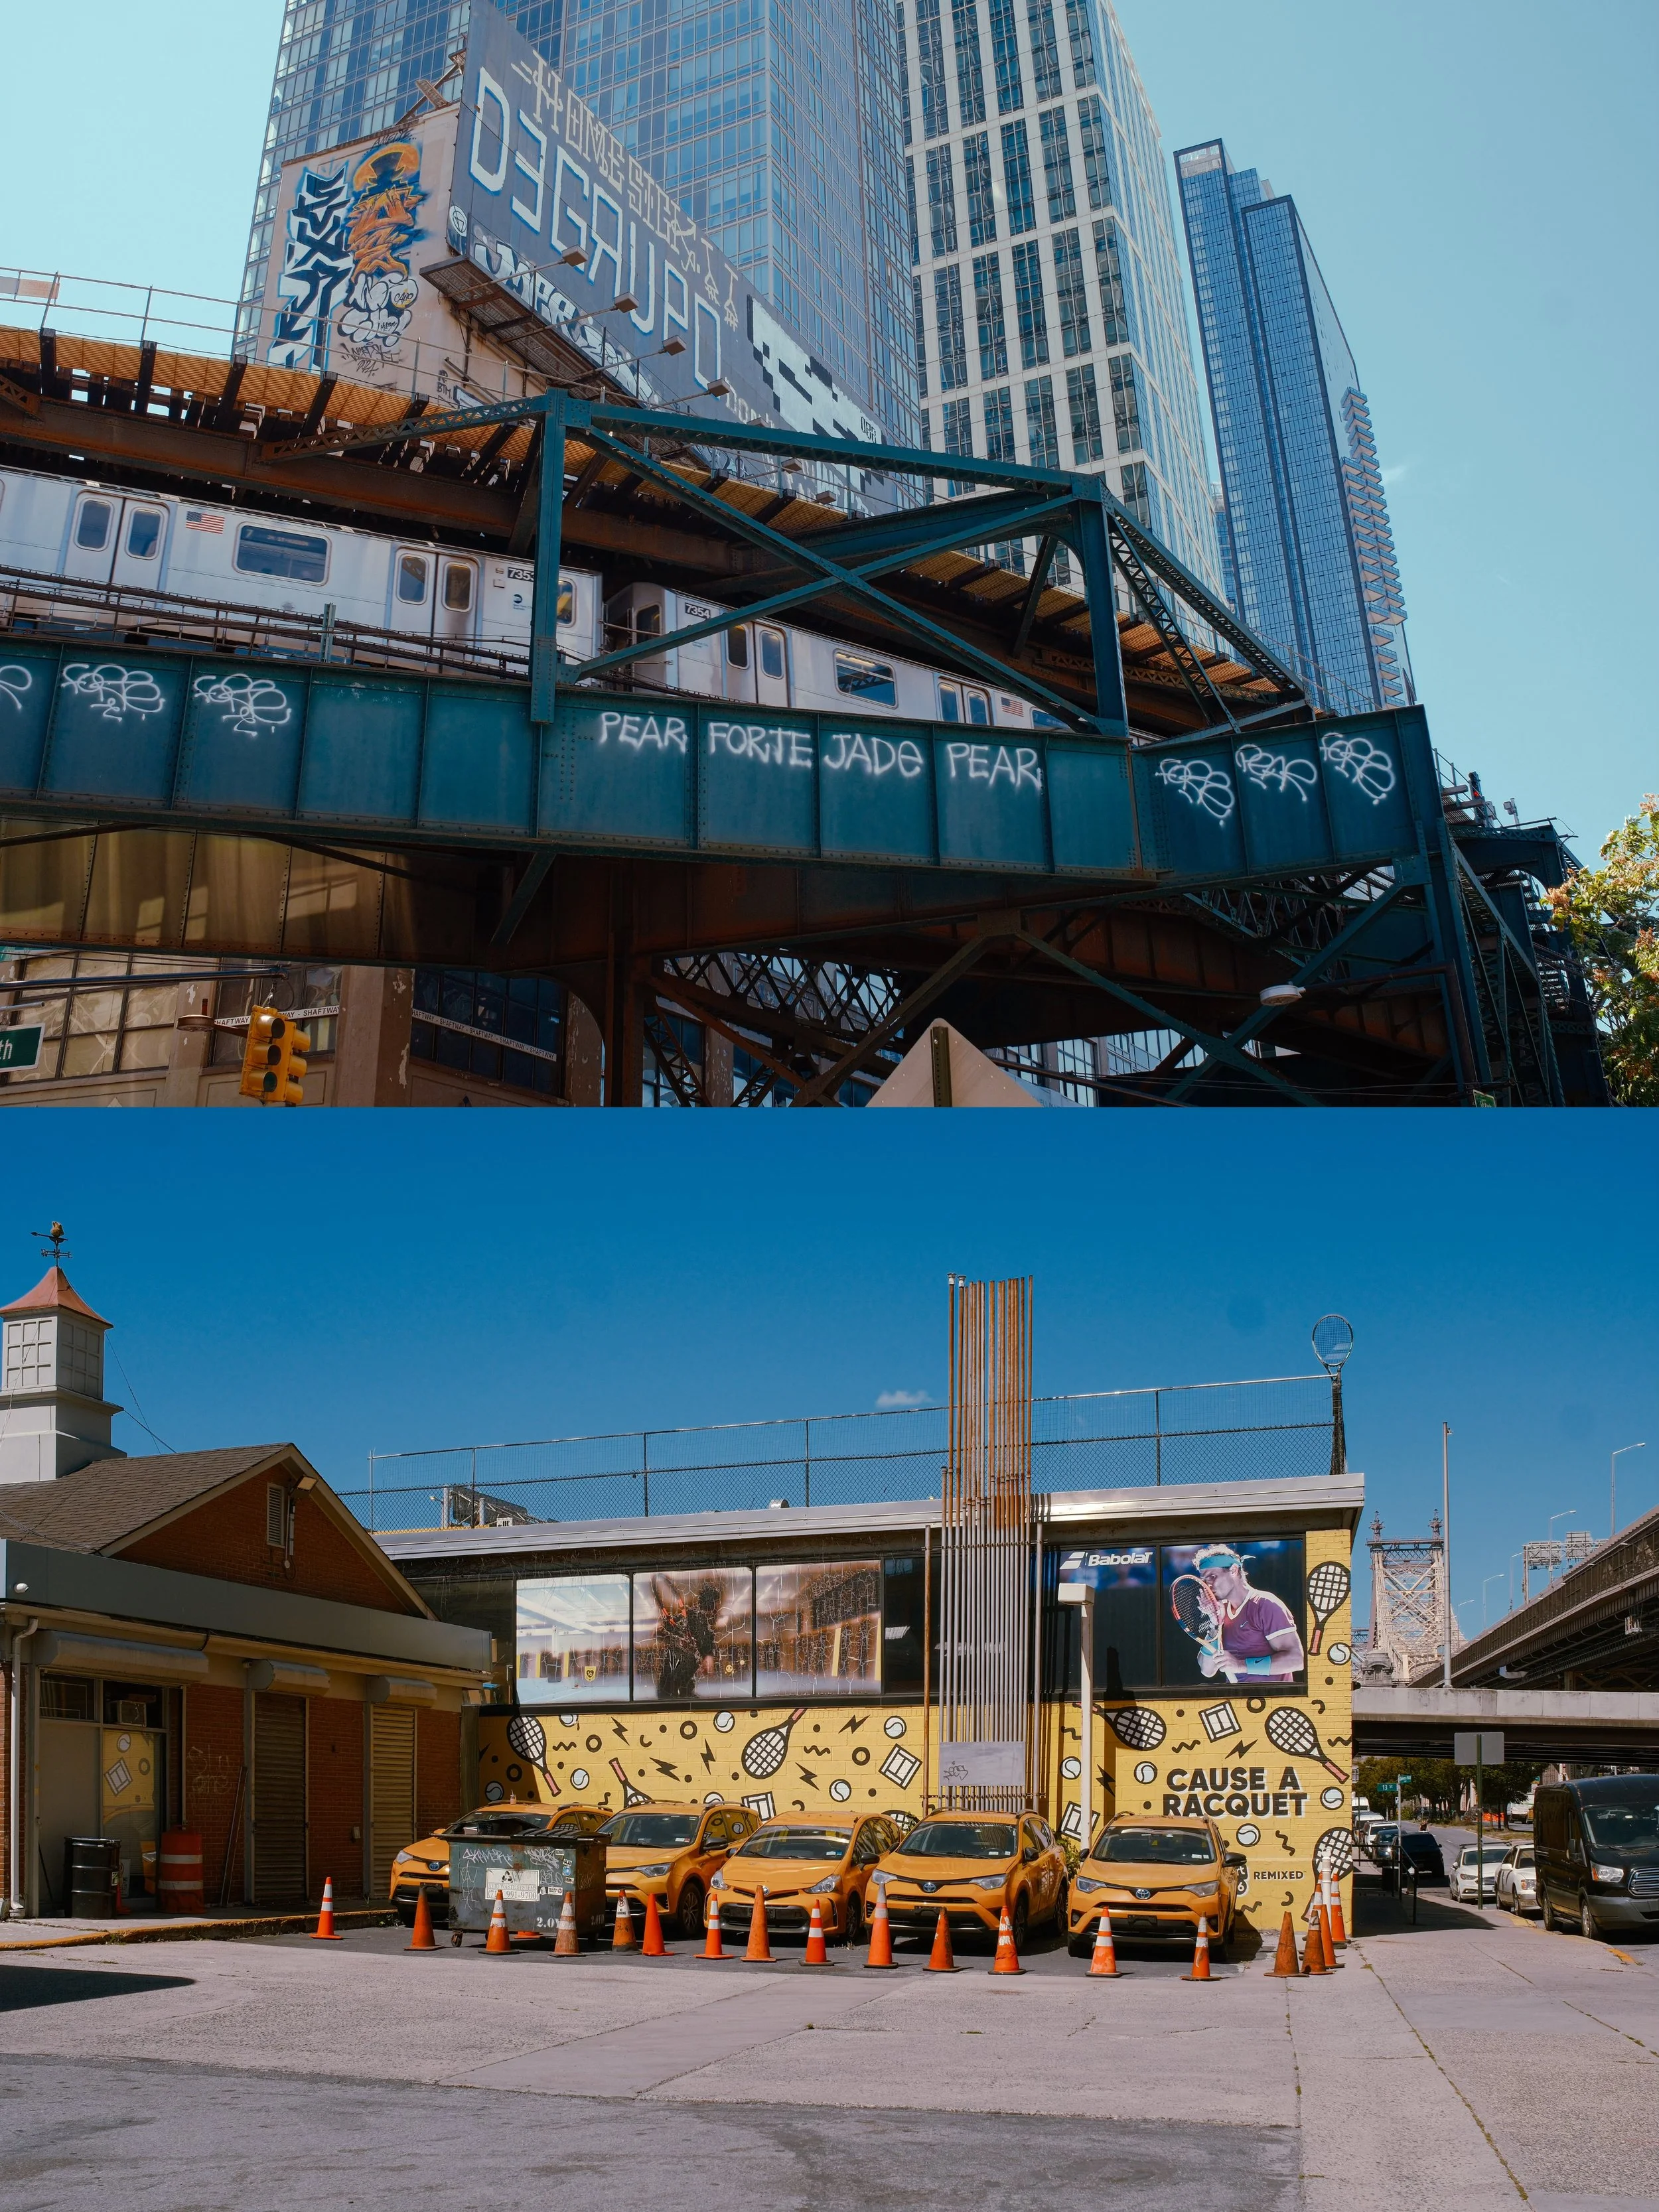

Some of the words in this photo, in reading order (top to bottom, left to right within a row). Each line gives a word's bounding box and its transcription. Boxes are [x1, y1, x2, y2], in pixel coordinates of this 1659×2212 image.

[685, 603, 711, 620] 7354
[599, 711, 687, 754] PEAR
[709, 721, 814, 770] FORTE
[946, 741, 1043, 791] PEAR
[303, 1006, 340, 1016] SHAFTWAY
[412, 1009, 435, 1022] HAFTWAY
[439, 1018, 465, 1031] SHAFTWAY
[469, 1028, 494, 1040] SHAFTWAY
[500, 1037, 525, 1050] SHAFTWAY
[530, 1046, 554, 1060] SHAFTWAY
[0, 1039, 13, 1060] th
[1167, 1766, 1266, 1791] CAUSE
[1279, 1766, 1300, 1791] A
[1163, 1793, 1308, 1818] RACQUET
[1254, 1871, 1304, 1880] REMIXED
[506, 1891, 537, 1900] 991-9700
